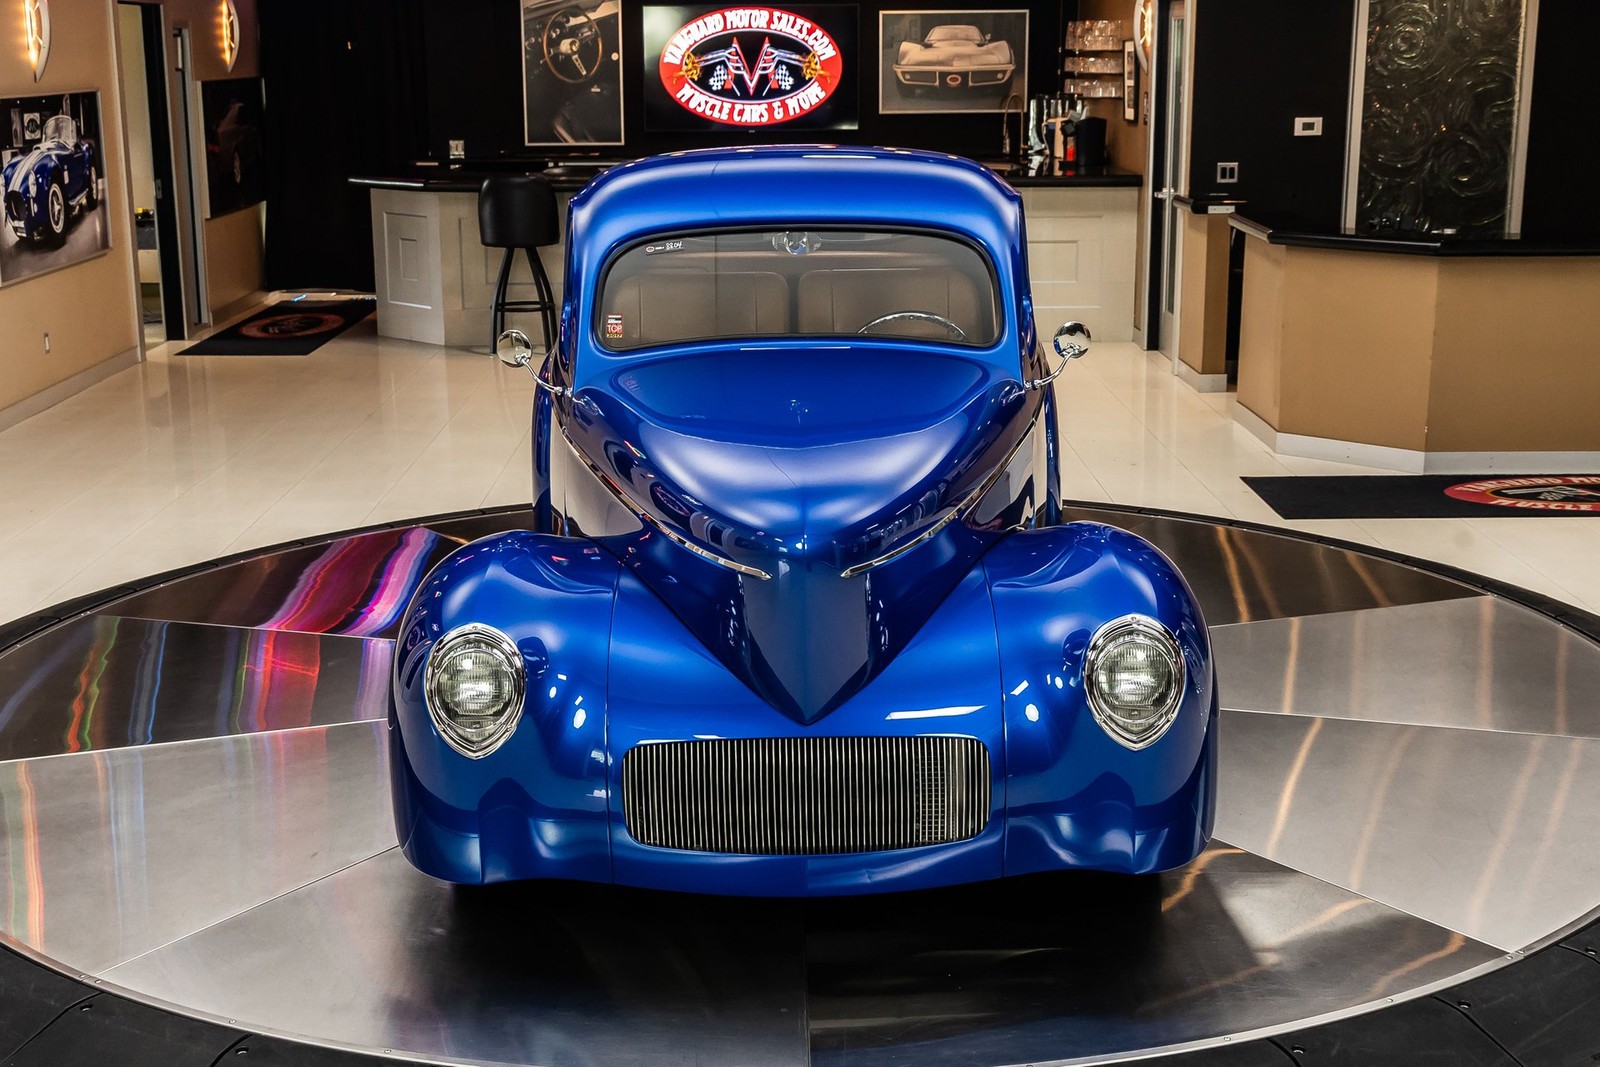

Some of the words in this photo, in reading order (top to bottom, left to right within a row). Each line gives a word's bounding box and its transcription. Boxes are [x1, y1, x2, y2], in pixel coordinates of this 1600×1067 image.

[664, 13, 724, 64] VANGUARD
[724, 9, 770, 29] MOTOR
[770, 11, 836, 60] SALES.COM
[676, 83, 730, 121] MUSCLE
[733, 103, 769, 123] CARS
[773, 104, 784, 120] &
[785, 82, 826, 116] MORE
[1454, 476, 1563, 493] VANGUARD
[1488, 498, 1593, 511] MUSCLE
